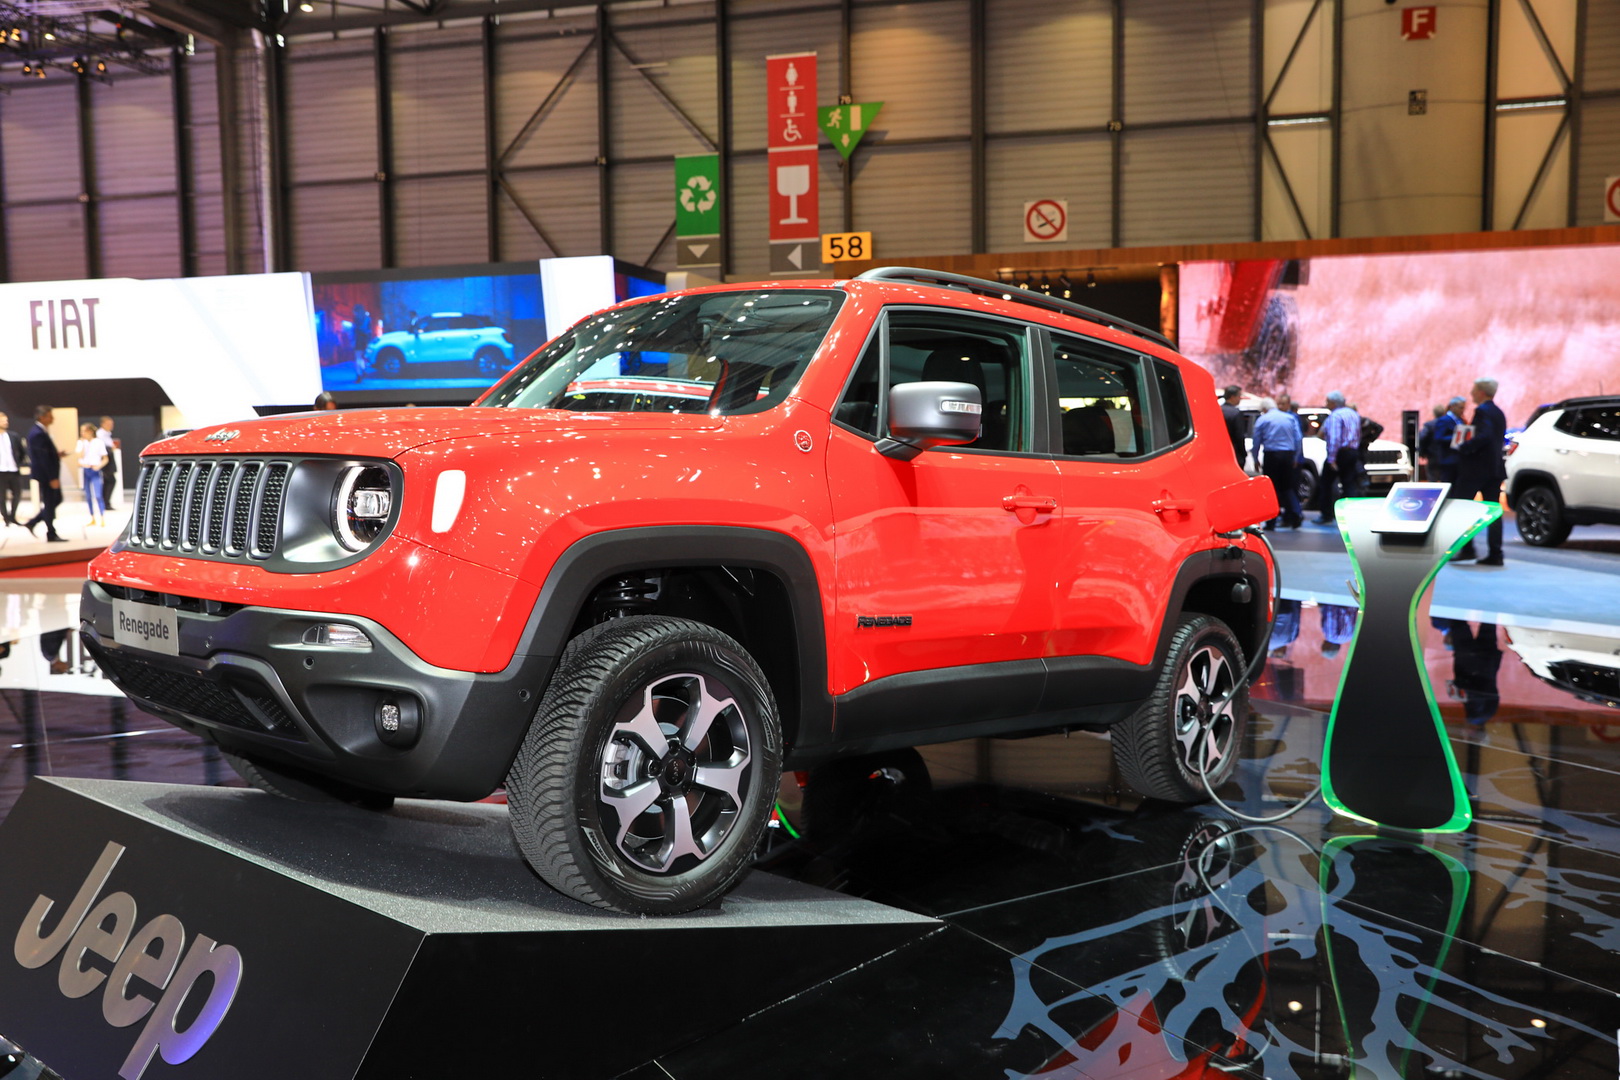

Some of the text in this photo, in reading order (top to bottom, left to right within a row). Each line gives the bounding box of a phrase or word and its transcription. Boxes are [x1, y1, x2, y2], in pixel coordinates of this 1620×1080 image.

[1412, 9, 1429, 32] F
[830, 236, 862, 259] 58
[29, 298, 100, 350] FIAT
[119, 611, 169, 641] Renegade
[857, 615, 912, 628] RENEGADE
[14, 840, 243, 1080] Jeep
